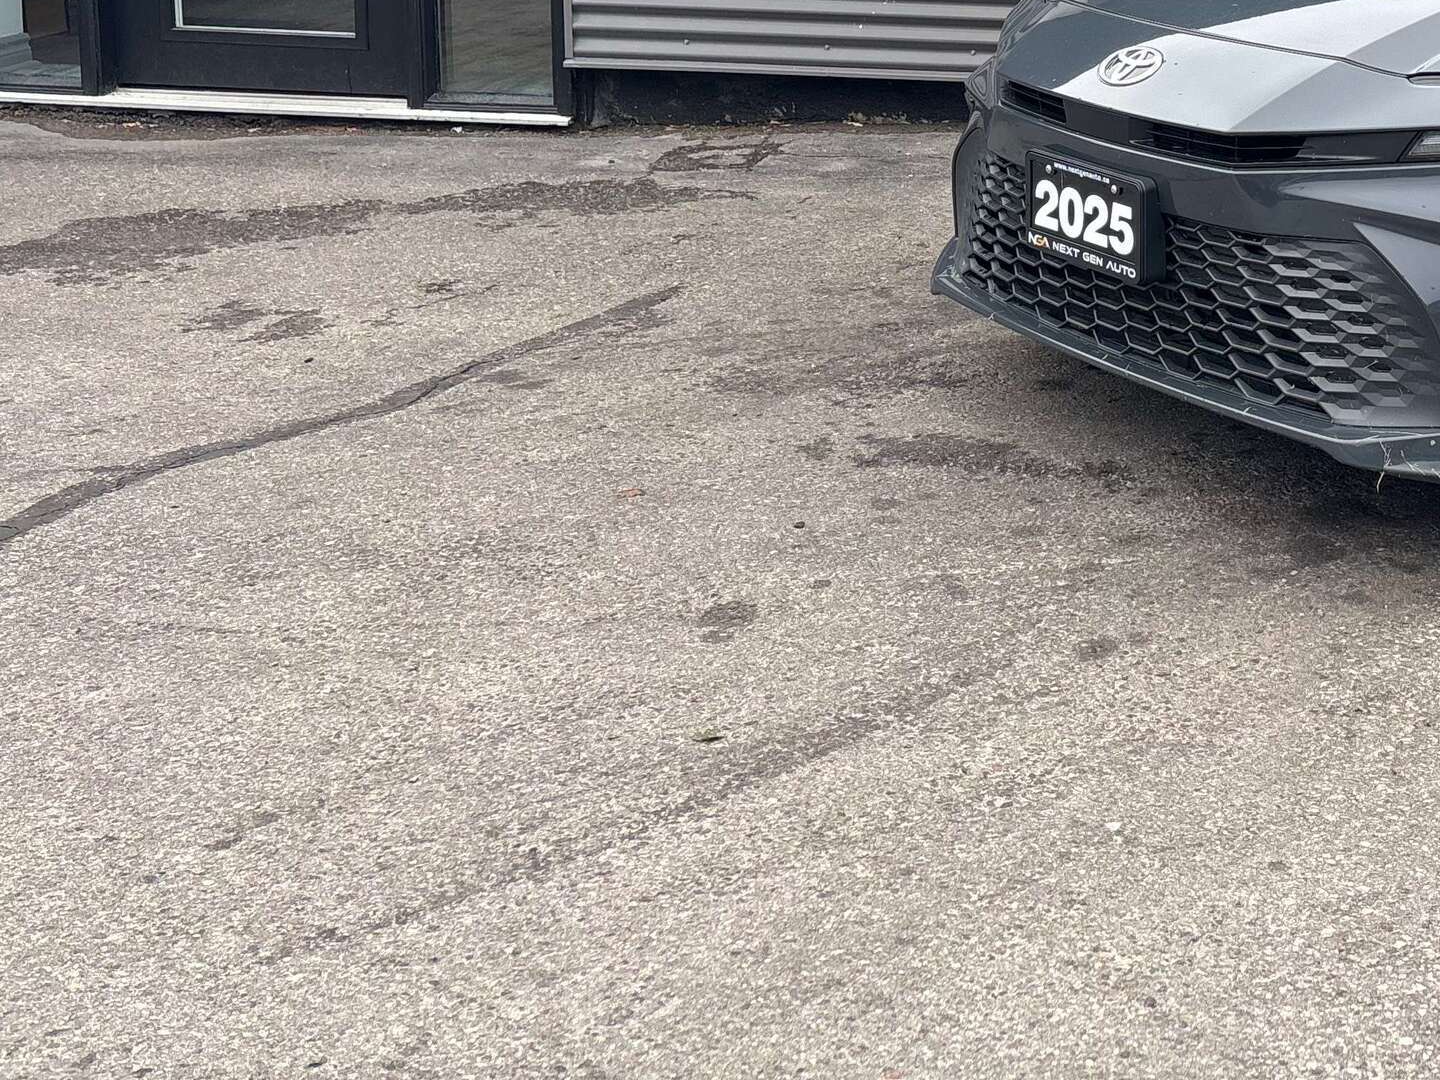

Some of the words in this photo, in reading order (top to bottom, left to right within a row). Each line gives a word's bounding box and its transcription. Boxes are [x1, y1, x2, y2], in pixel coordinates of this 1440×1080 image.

[1034, 179, 1135, 256] 2025
[1028, 232, 1050, 248] NGA
[1052, 241, 1080, 258] NEXT
[1082, 252, 1104, 267] GEN
[1106, 261, 1137, 278] AUTO
